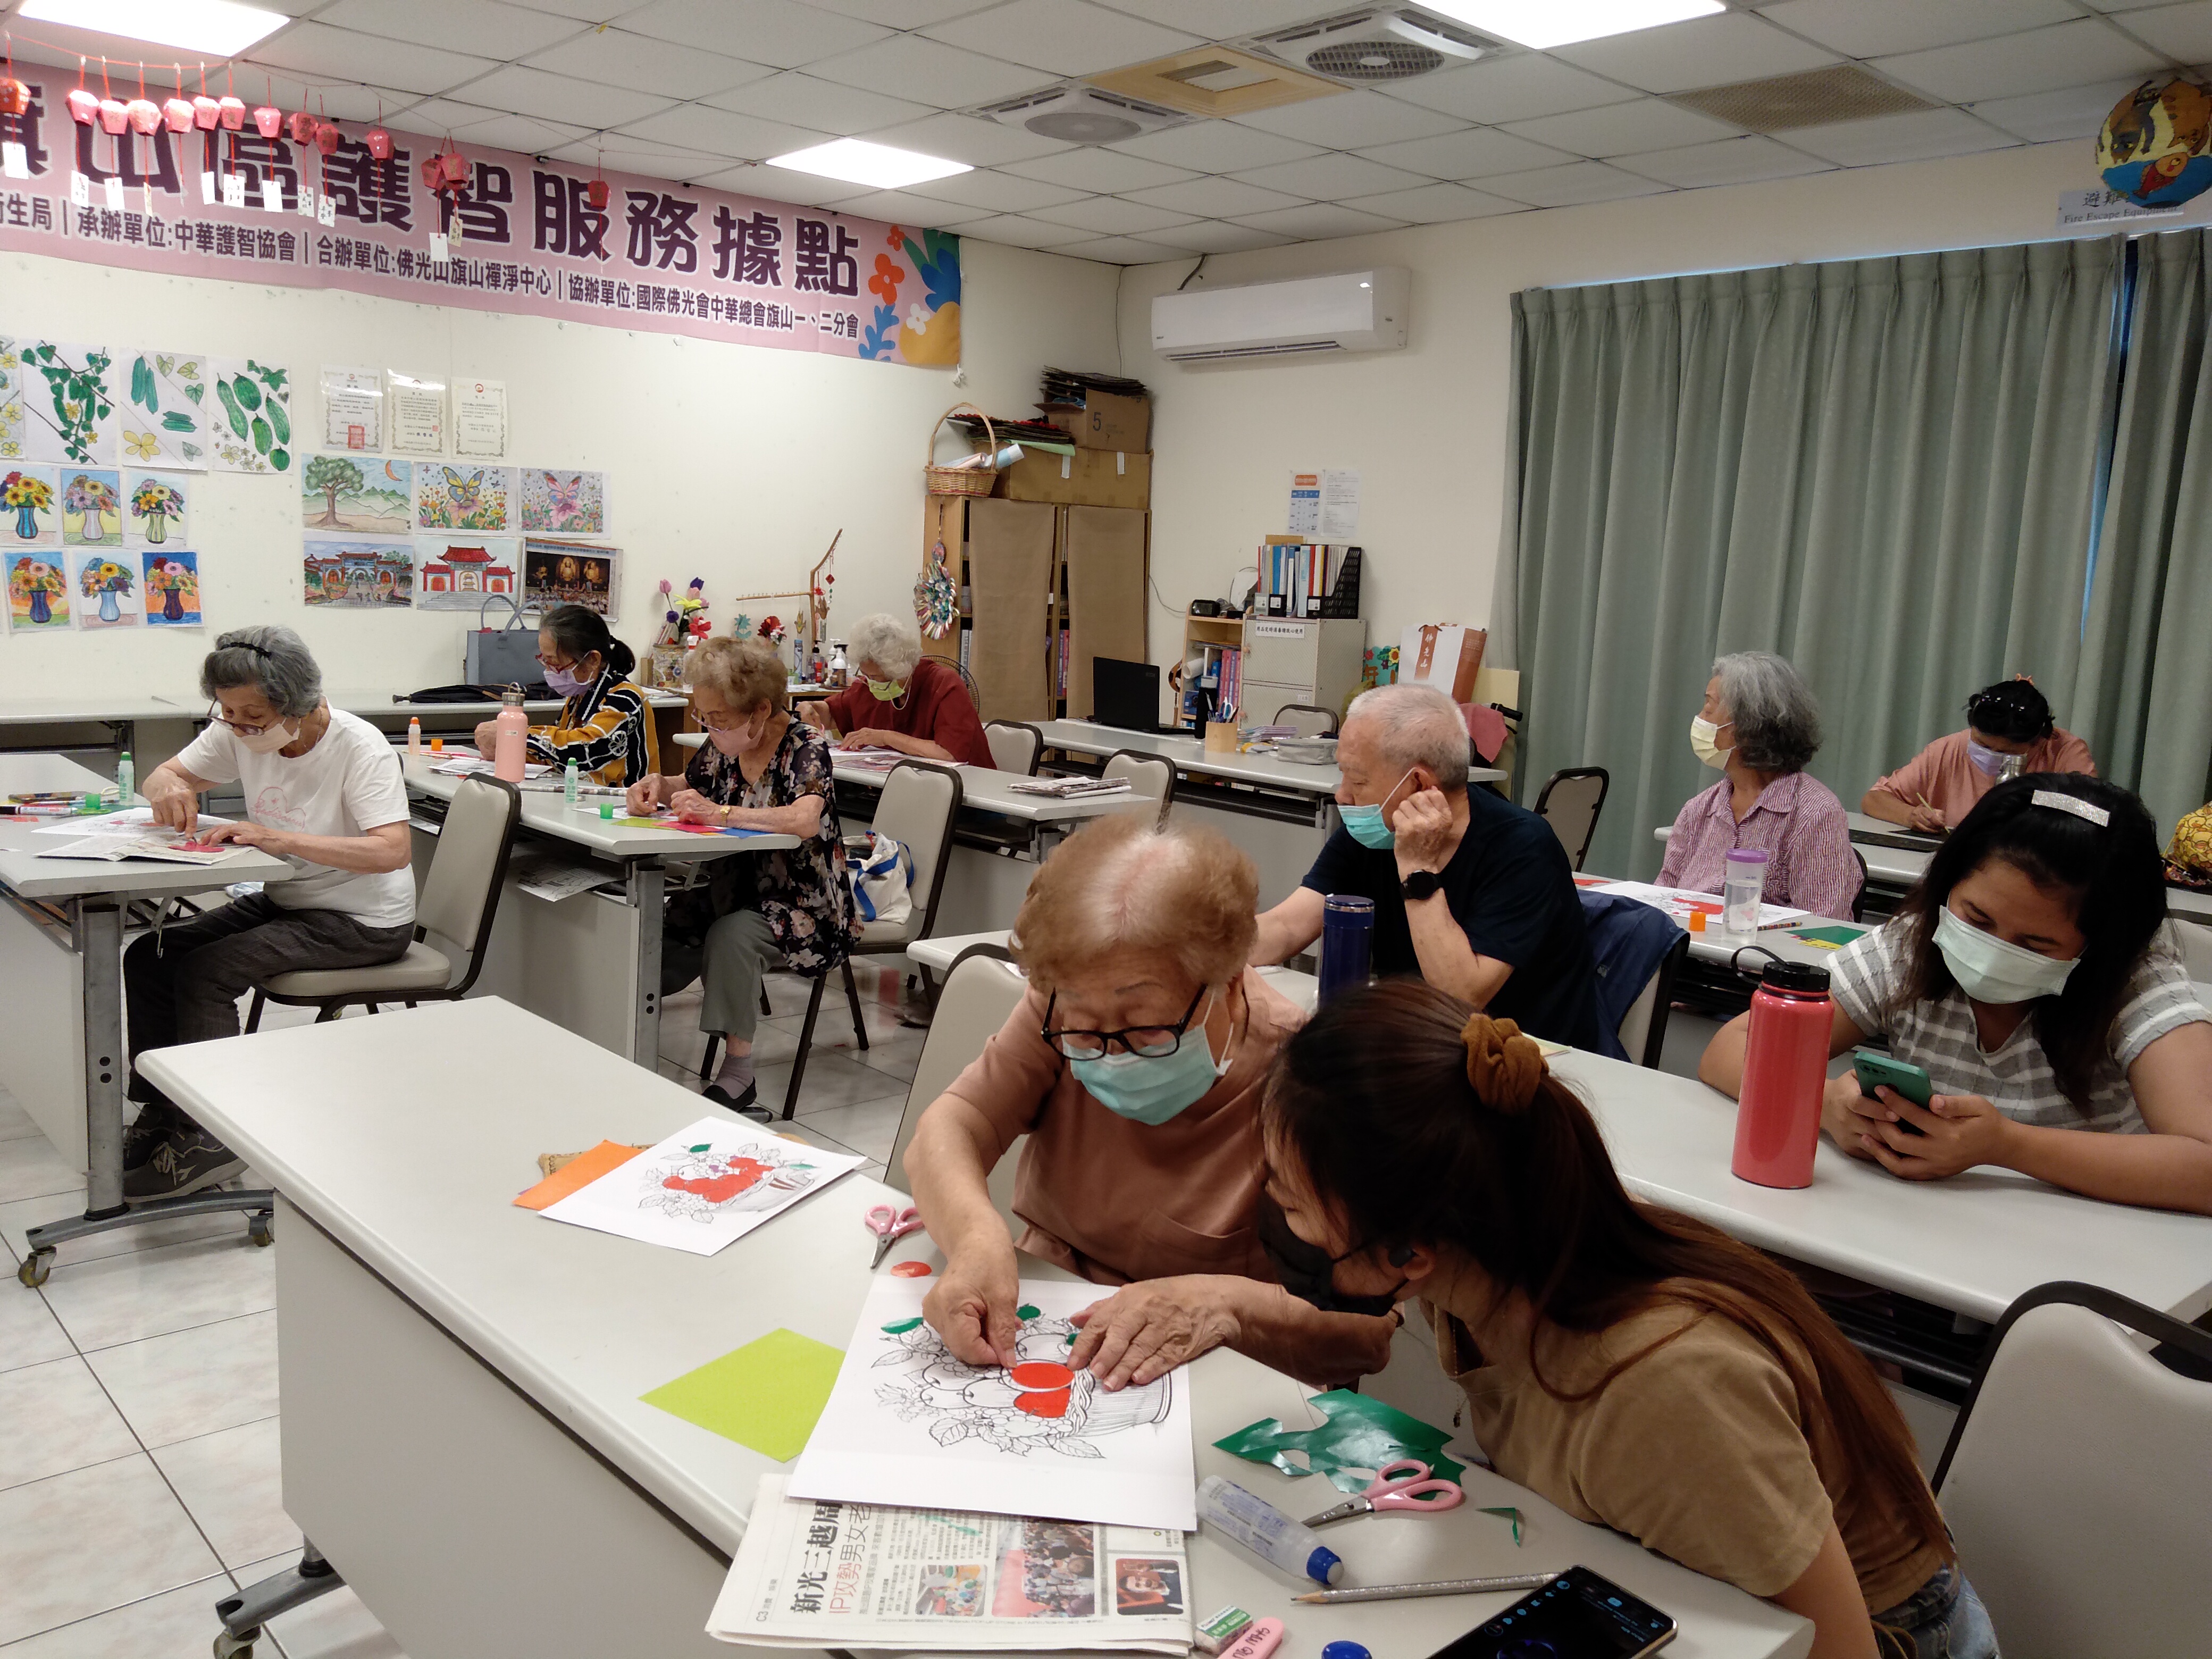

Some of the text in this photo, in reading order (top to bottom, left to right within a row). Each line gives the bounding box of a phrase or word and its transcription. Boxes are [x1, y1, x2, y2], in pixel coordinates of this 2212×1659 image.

[2082, 191, 2129, 207] 避難
[0, 192, 52, 230] 生局
[2064, 215, 2083, 223] Fire
[2087, 212, 2119, 221] Escape
[1093, 412, 1101, 431] 5
[1420, 633, 1433, 667] 佛光山
[756, 1611, 769, 1622] C3
